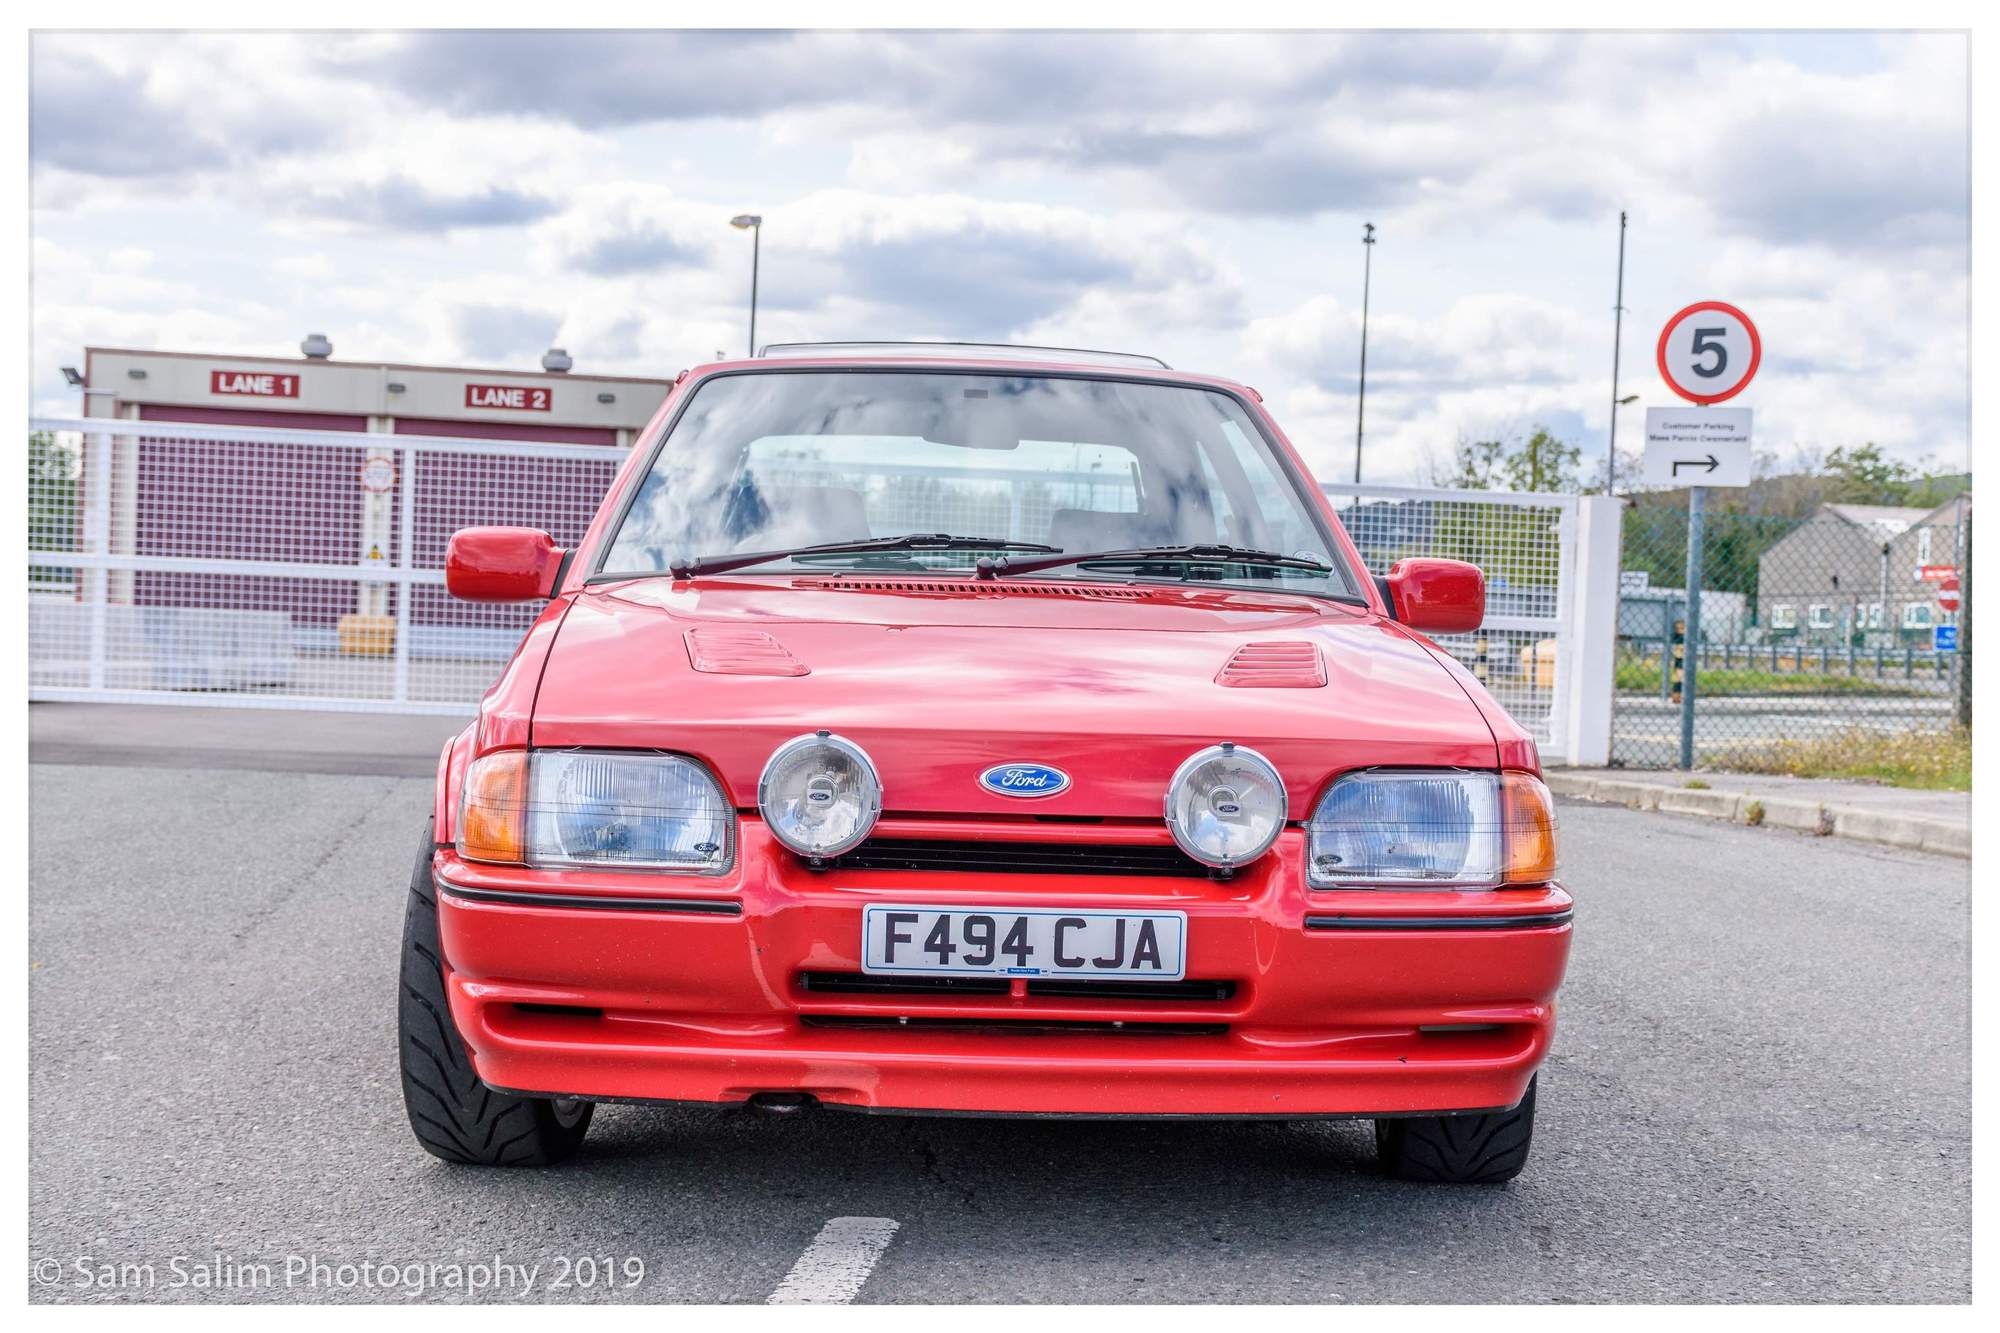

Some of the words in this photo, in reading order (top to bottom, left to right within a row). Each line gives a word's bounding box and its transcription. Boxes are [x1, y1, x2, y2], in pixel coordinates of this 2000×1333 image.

[1691, 327, 1728, 378] 5
[219, 373, 274, 395] LANE
[281, 377, 292, 395] 1
[471, 387, 526, 408] LANE
[532, 390, 546, 409] 2
[1662, 422, 1701, 430] Customer
[1703, 423, 1736, 432] Parking
[1002, 769, 1047, 787] Ford
[884, 913, 1034, 967] F494
[1053, 917, 1162, 970] CJA
